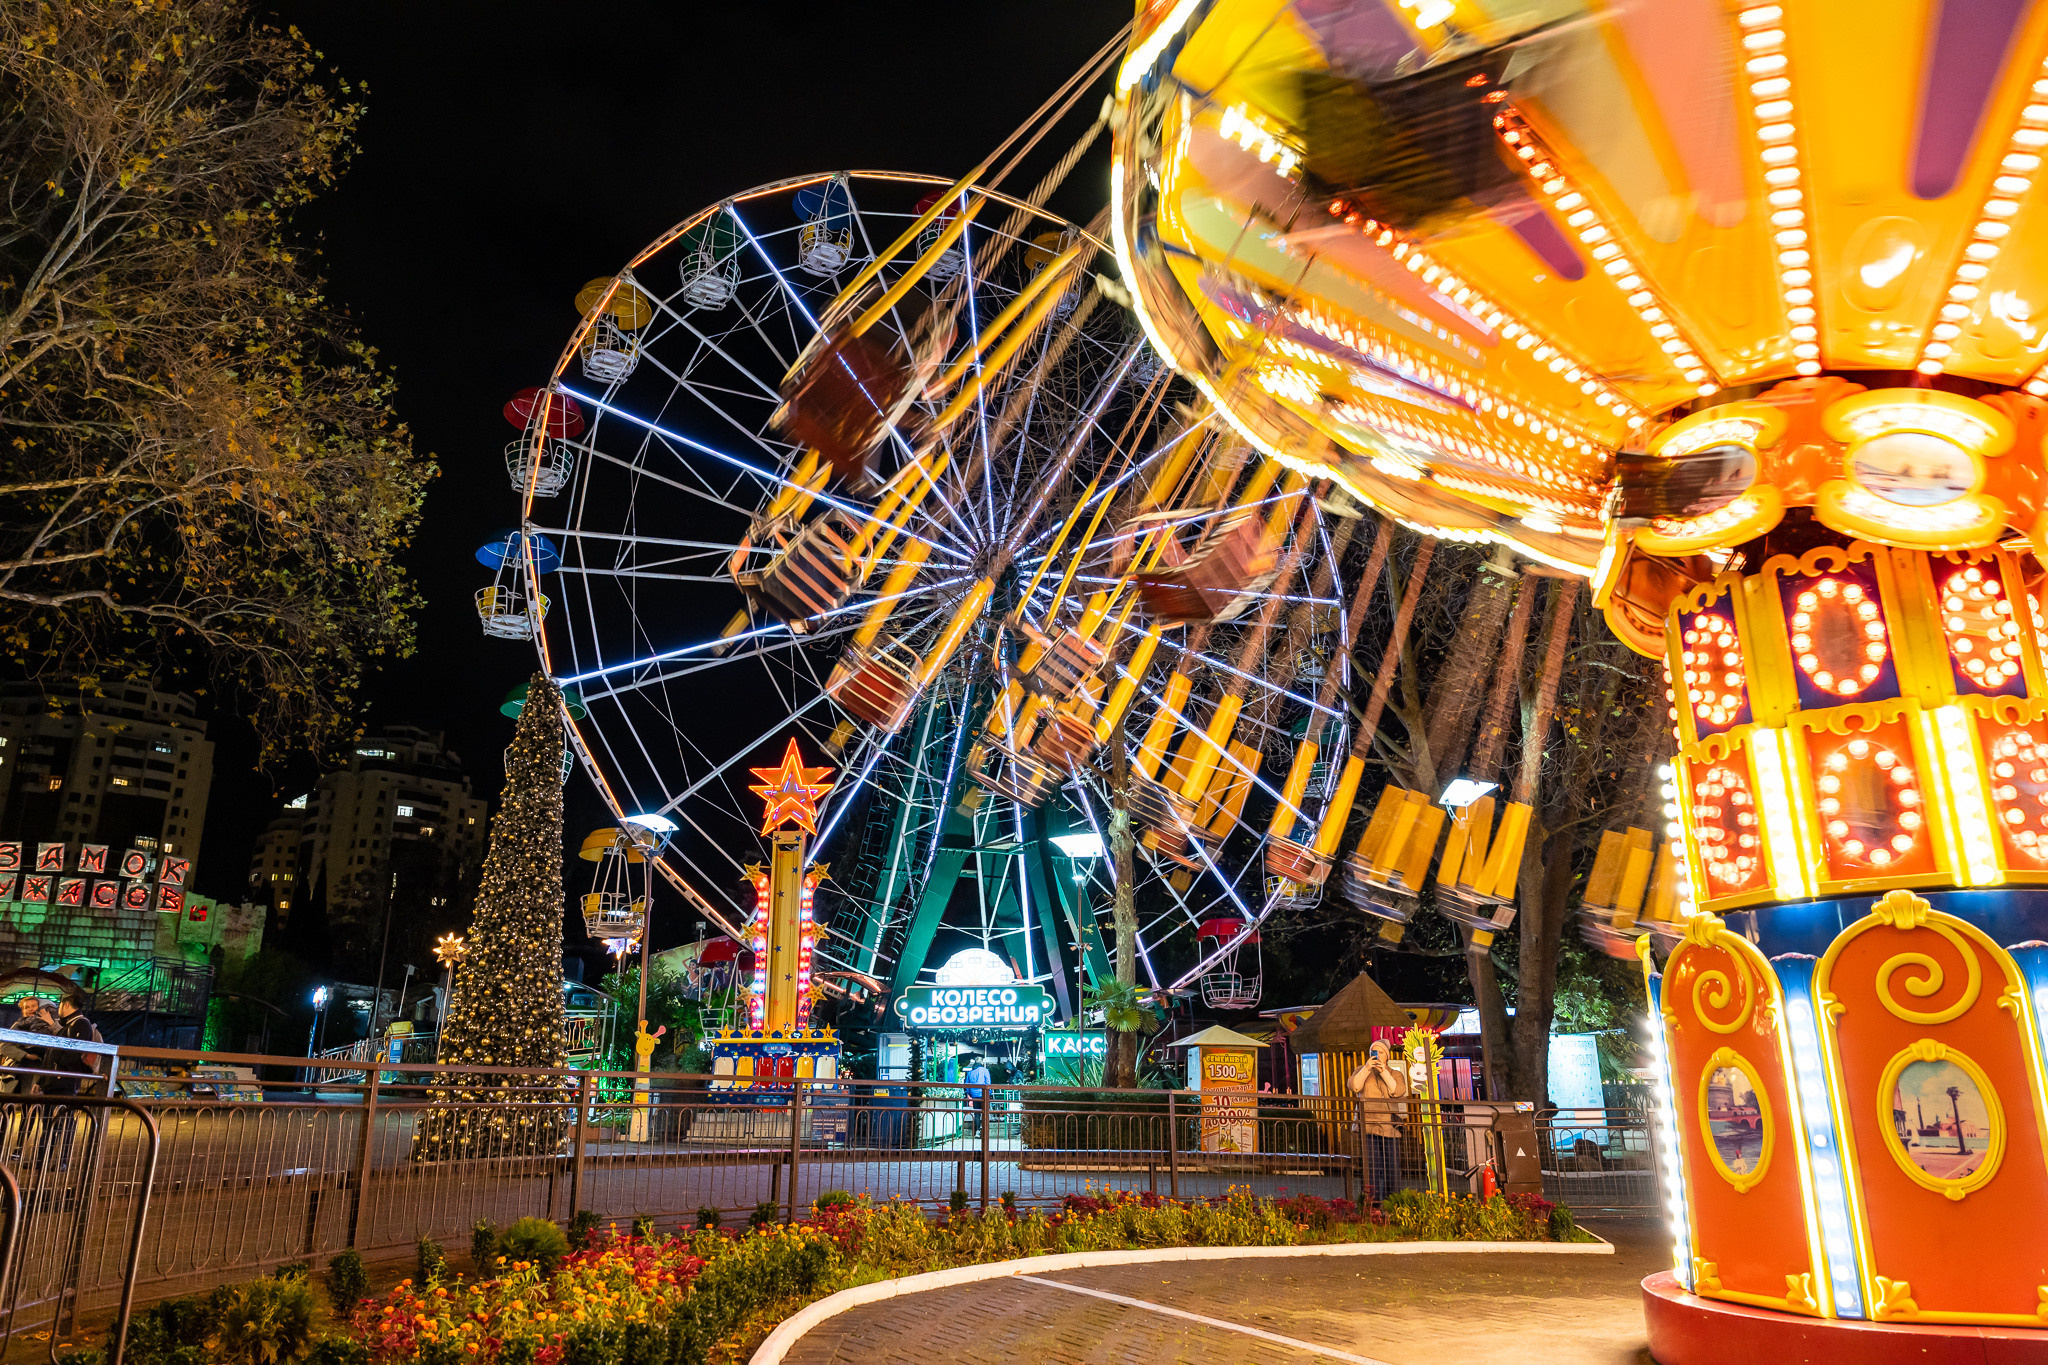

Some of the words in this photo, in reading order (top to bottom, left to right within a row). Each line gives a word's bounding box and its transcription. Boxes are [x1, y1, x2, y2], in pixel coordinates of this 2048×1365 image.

[931, 989, 1017, 1006] КОЛЕСО
[911, 1005, 1039, 1023] ОБОЗРЕНИЯ
[1048, 1037, 1107, 1053] КАСС
[1208, 1064, 1236, 1078] 1500
[1213, 1096, 1231, 1110] 10
